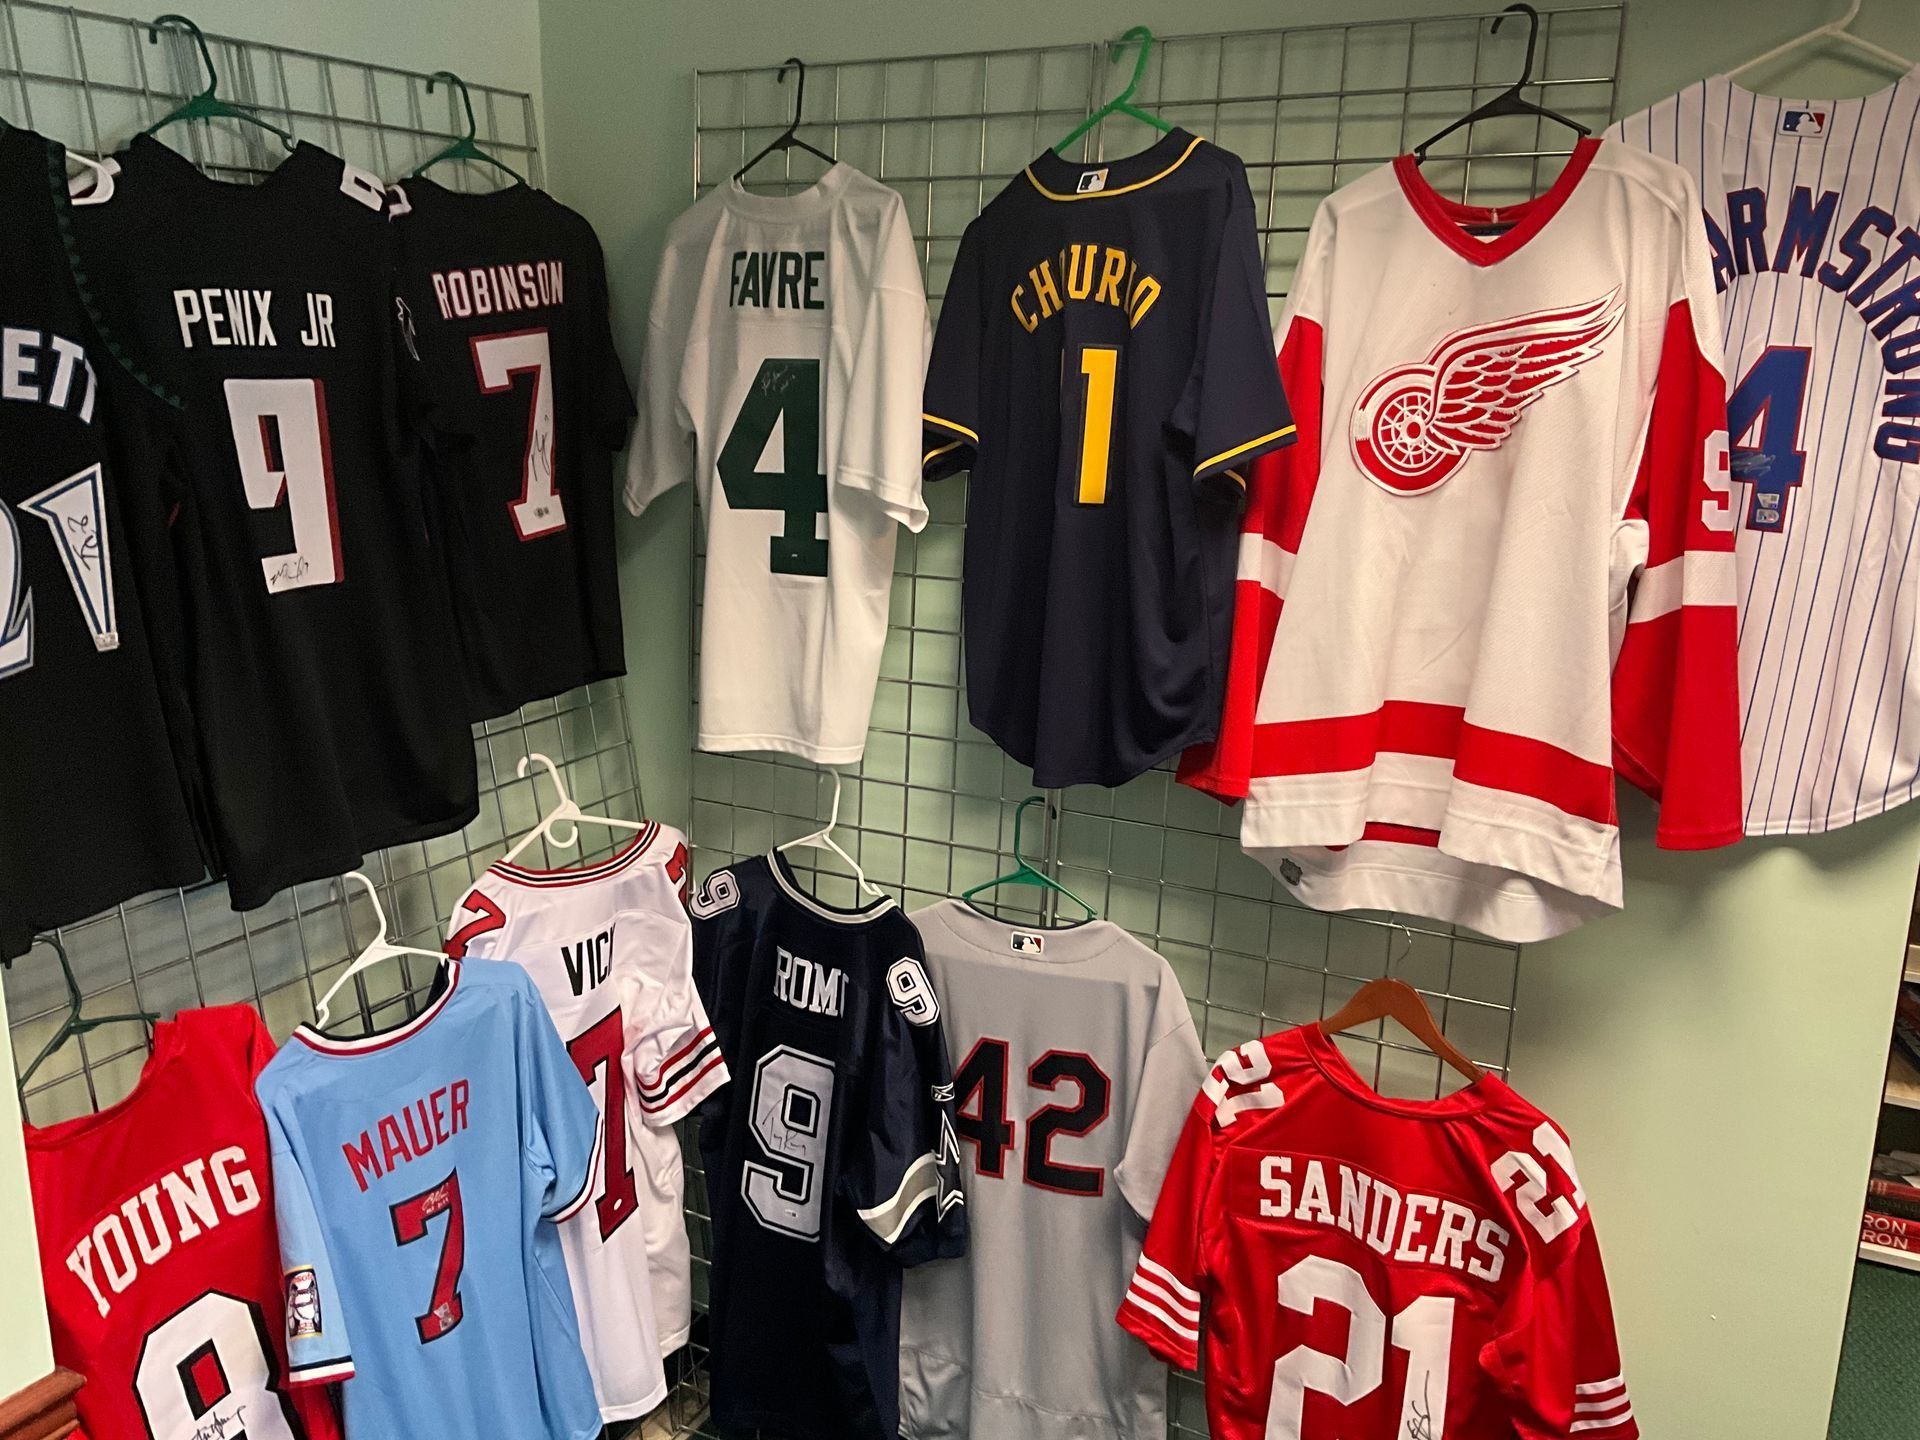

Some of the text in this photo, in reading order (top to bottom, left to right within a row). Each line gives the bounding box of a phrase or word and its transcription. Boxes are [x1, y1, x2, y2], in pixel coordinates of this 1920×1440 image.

[174, 288, 336, 348] PENIX JR
[431, 261, 564, 319] ROBINSON
[729, 250, 825, 310] FAVRE
[1010, 244, 1162, 334] CHURO
[223, 378, 345, 594] 9
[469, 327, 568, 542] 7
[717, 358, 828, 577] 4
[1075, 345, 1118, 505] 1
[1726, 345, 1807, 533] 4
[443, 889, 506, 961] 7
[561, 922, 616, 997] VIC
[689, 869, 740, 920] 9
[886, 956, 939, 1026] 9
[341, 1078, 470, 1192] MAUER
[565, 1004, 639, 1243] 7
[741, 1044, 836, 1243] 9
[952, 1037, 1111, 1197] 42
[1202, 1040, 1284, 1128] 21
[66, 1145, 261, 1318] YOUNG
[389, 1166, 465, 1345] 7
[1259, 1155, 1510, 1283] SANDERS
[1265, 1254, 1455, 1440] 21
